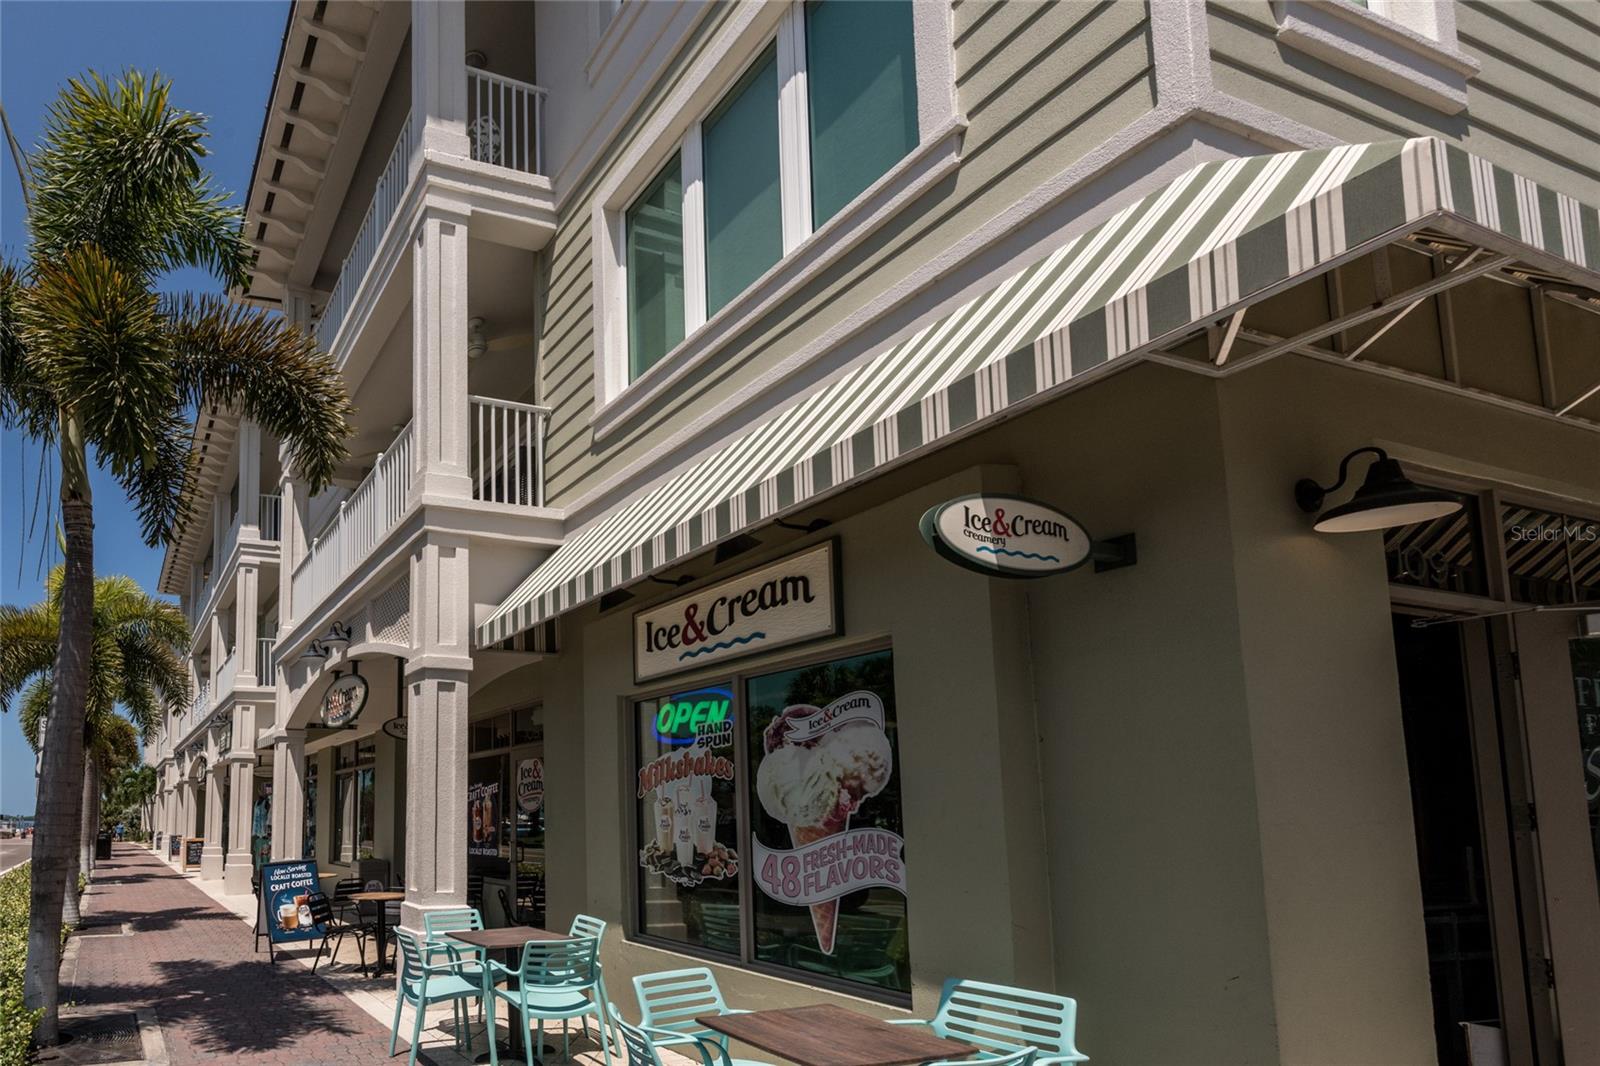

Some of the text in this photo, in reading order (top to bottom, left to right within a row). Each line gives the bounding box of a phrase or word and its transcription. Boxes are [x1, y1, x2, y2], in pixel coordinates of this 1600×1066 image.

[963, 505, 1070, 542] Ice&Cream
[963, 528, 1006, 547] creamery
[645, 575, 816, 653] Ice&Cream
[656, 700, 729, 733] OPEN
[697, 721, 733, 736] HAND
[697, 733, 732, 748] SPUN
[638, 751, 734, 797] Milkshakes
[481, 782, 499, 797] COFFEE
[518, 780, 545, 796] Cream
[803, 833, 898, 874] FRESH-MADE
[286, 864, 307, 874] Serving
[761, 853, 802, 897] 48
[803, 856, 901, 897] FLAVORS
[270, 879, 313, 891] CRAFT COFFEE
